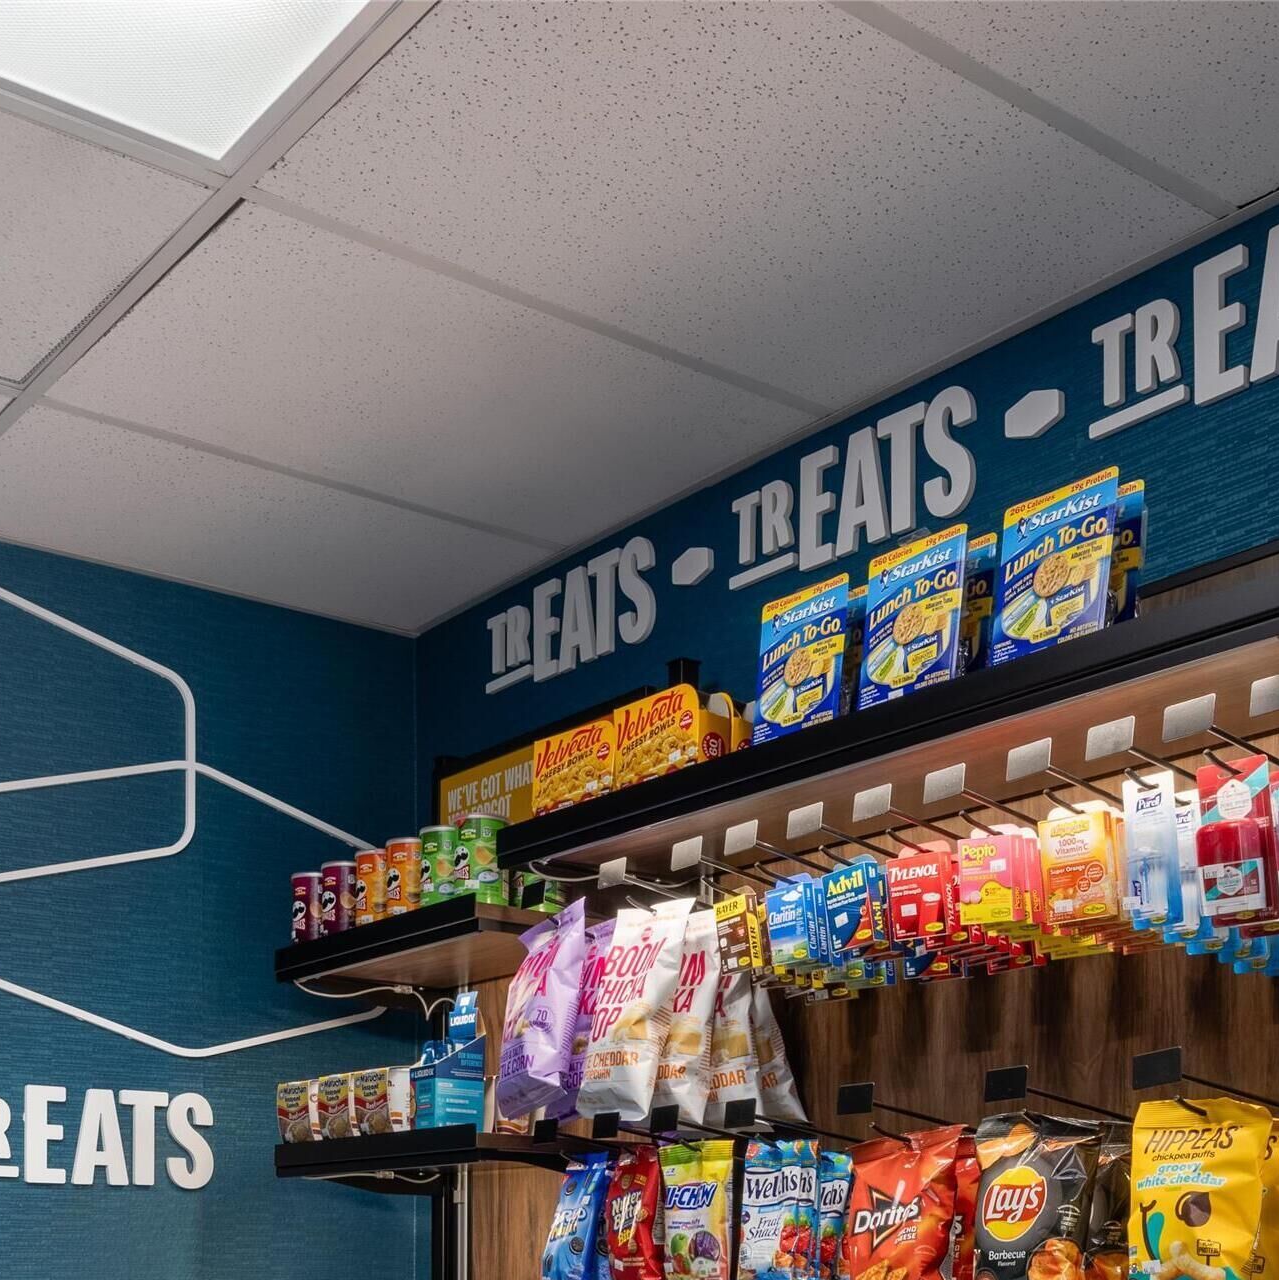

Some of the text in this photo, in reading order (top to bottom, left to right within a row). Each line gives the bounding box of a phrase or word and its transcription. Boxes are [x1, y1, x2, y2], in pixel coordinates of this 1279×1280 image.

[730, 386, 977, 588] TREATS
[1027, 471, 1112, 511] Calories Protein
[1029, 492, 1102, 531] StarKist
[891, 548, 952, 582] StarKist
[1004, 535, 1054, 584] Lunch
[486, 536, 657, 692] TREATS
[782, 596, 836, 626] StarKist
[869, 587, 912, 632] Lunch
[762, 632, 801, 672] Lunch
[616, 691, 684, 751] Velveeta
[622, 716, 675, 756] CHEESY BOWLS
[536, 725, 604, 779] Velveeta
[539, 749, 593, 783] CHEESY BOWLS
[448, 772, 502, 812] WE'VE GOT
[1136, 792, 1162, 813] Purell
[961, 845, 997, 863] Pepto
[1055, 846, 1082, 856] Vitamin
[826, 870, 864, 898] Advil
[889, 864, 939, 883] TYLENOL
[716, 900, 738, 916] BAYER
[769, 911, 796, 926] Claritin
[945, 882, 956, 927] TYLENOL
[593, 1051, 639, 1069] CHEDDAR
[1144, 1125, 1235, 1155] HIPPEAS
[1152, 1150, 1215, 1162] chickpea puffs
[1137, 1173, 1225, 1190] white cheddar
[1158, 1162, 1202, 1176] groovy
[985, 1183, 1043, 1222] Lay's
[988, 1249, 1026, 1260] Barbecue
